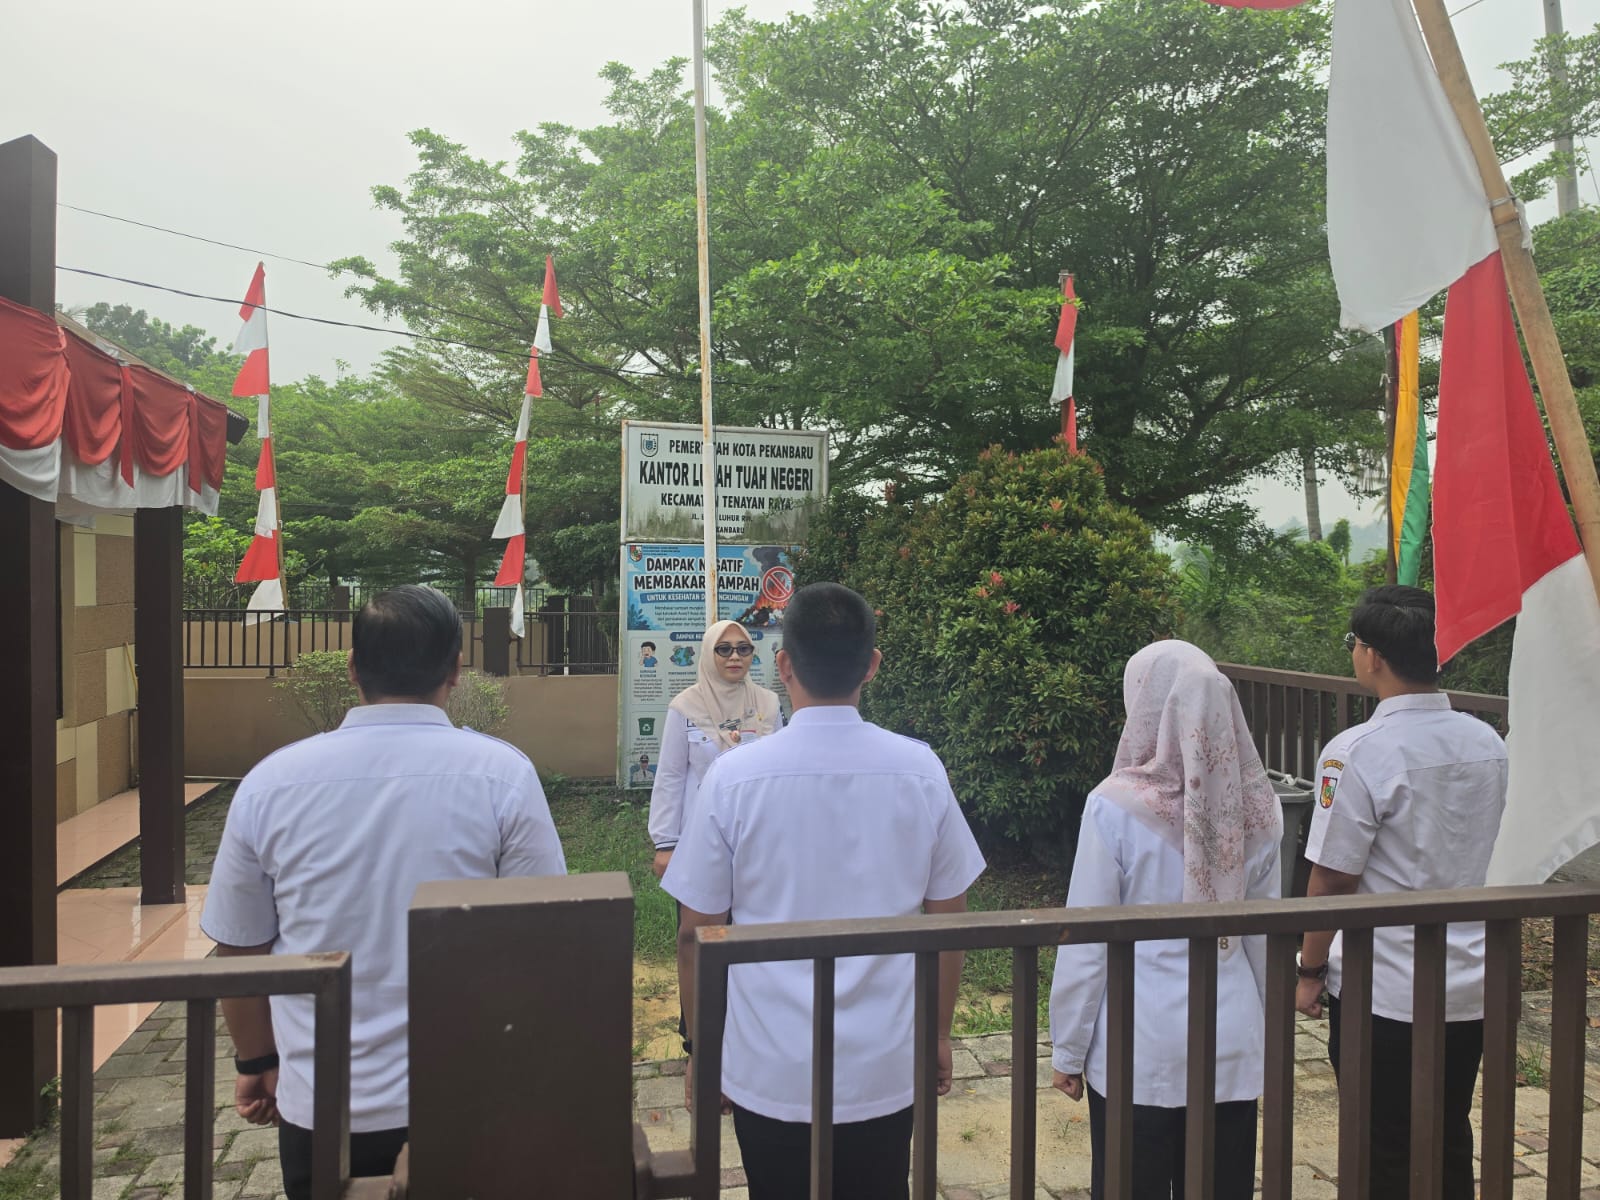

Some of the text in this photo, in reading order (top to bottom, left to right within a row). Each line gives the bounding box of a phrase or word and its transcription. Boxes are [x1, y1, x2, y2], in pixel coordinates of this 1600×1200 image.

[732, 443, 756, 457] KOTA
[759, 444, 814, 459] PEKANBARU
[639, 460, 689, 486] KANTOR
[736, 465, 767, 490] TUAH
[771, 466, 813, 491] NEGERI
[661, 492, 719, 508] KECAMATN
[722, 495, 765, 510] TENAYAN
[719, 514, 739, 522] LUHUR
[646, 557, 744, 573] DAMPAK NGATIF
[634, 574, 760, 592] MEMBAKAR AMPAH
[646, 593, 668, 602] UNTUK
[668, 593, 700, 601] KESEHATAN
